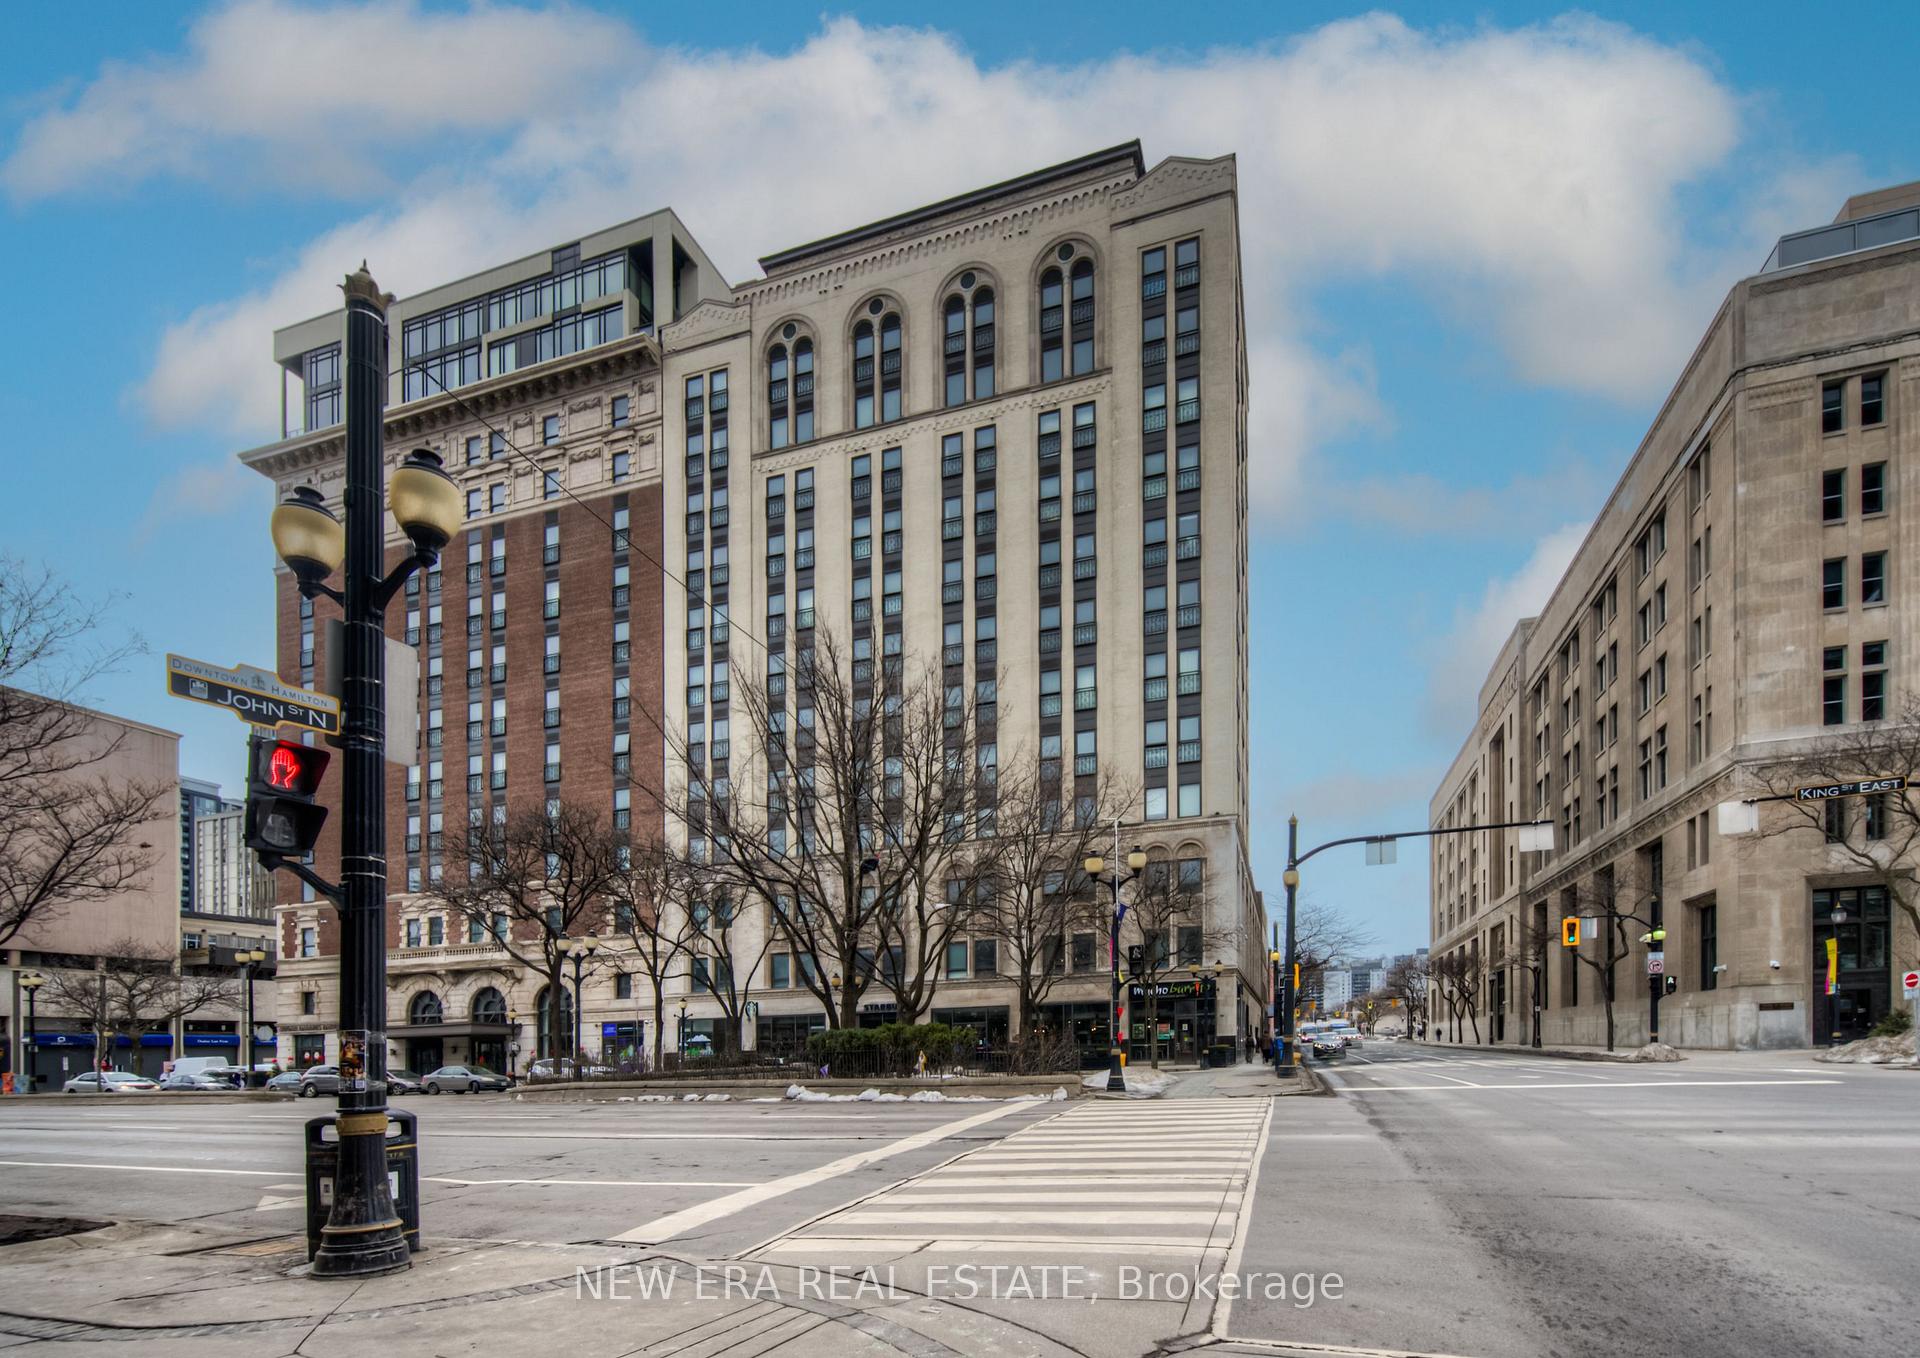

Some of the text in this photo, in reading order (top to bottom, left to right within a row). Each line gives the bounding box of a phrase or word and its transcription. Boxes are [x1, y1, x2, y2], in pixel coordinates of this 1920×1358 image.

[171, 658, 329, 708] DOWNTOWN HAMILTON
[217, 689, 285, 719] JOHN
[308, 711, 327, 729] N
[1800, 786, 1839, 800] KING
[1859, 779, 1902, 793] EAST
[1169, 982, 1212, 995] burrt
